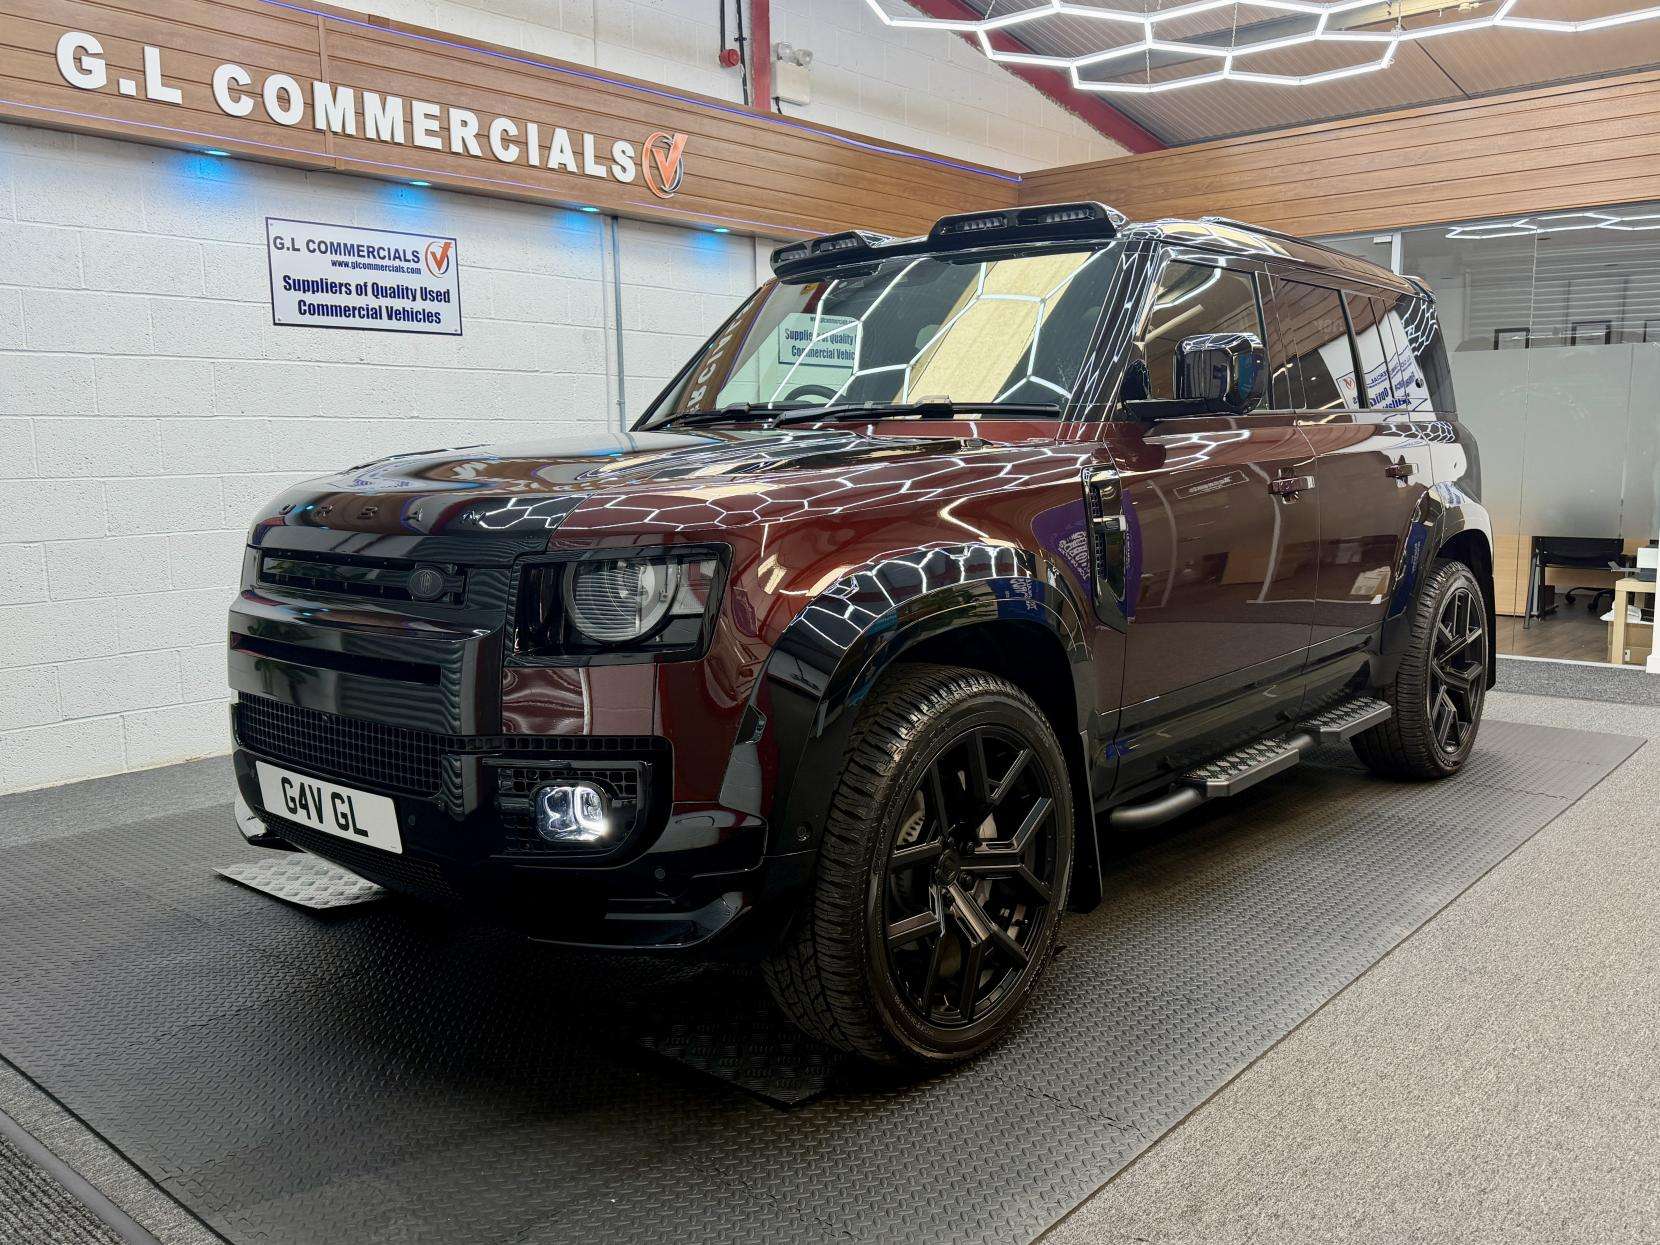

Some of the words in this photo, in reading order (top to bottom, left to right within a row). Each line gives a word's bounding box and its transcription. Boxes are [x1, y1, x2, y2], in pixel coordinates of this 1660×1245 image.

[56, 30, 183, 105] G.L
[212, 63, 637, 184] COMMERCIALS
[272, 235, 301, 252] G.L
[305, 238, 421, 264] COMMERCIALS
[331, 258, 422, 275] www.glcommercials.com
[282, 274, 352, 296] Suppliers
[355, 281, 368, 297] of
[371, 281, 418, 303] Quality
[419, 286, 451, 304] Used
[297, 299, 383, 320] Commercial
[385, 305, 442, 325] Vehicles
[784, 328, 820, 342] Supplie
[330, 791, 370, 838] GL
